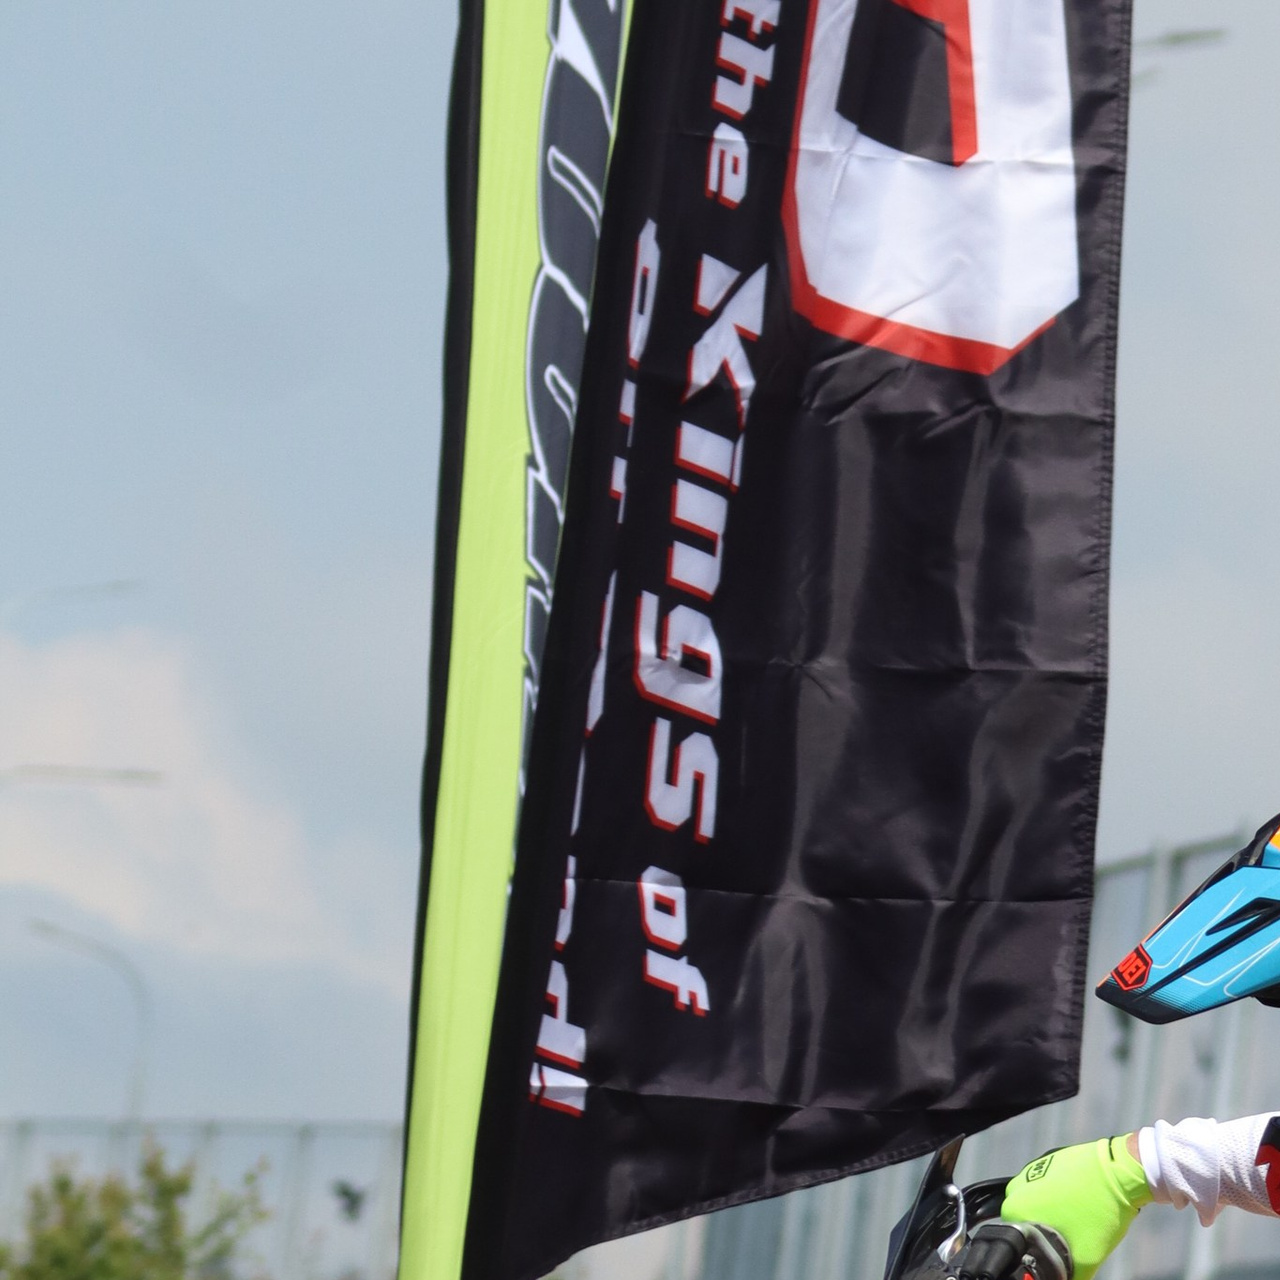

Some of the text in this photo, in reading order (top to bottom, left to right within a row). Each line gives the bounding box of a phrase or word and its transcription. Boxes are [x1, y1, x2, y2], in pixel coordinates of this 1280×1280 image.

[633, 253, 768, 844] Kings
[638, 866, 711, 1017] of
[1117, 952, 1147, 984] OEI
